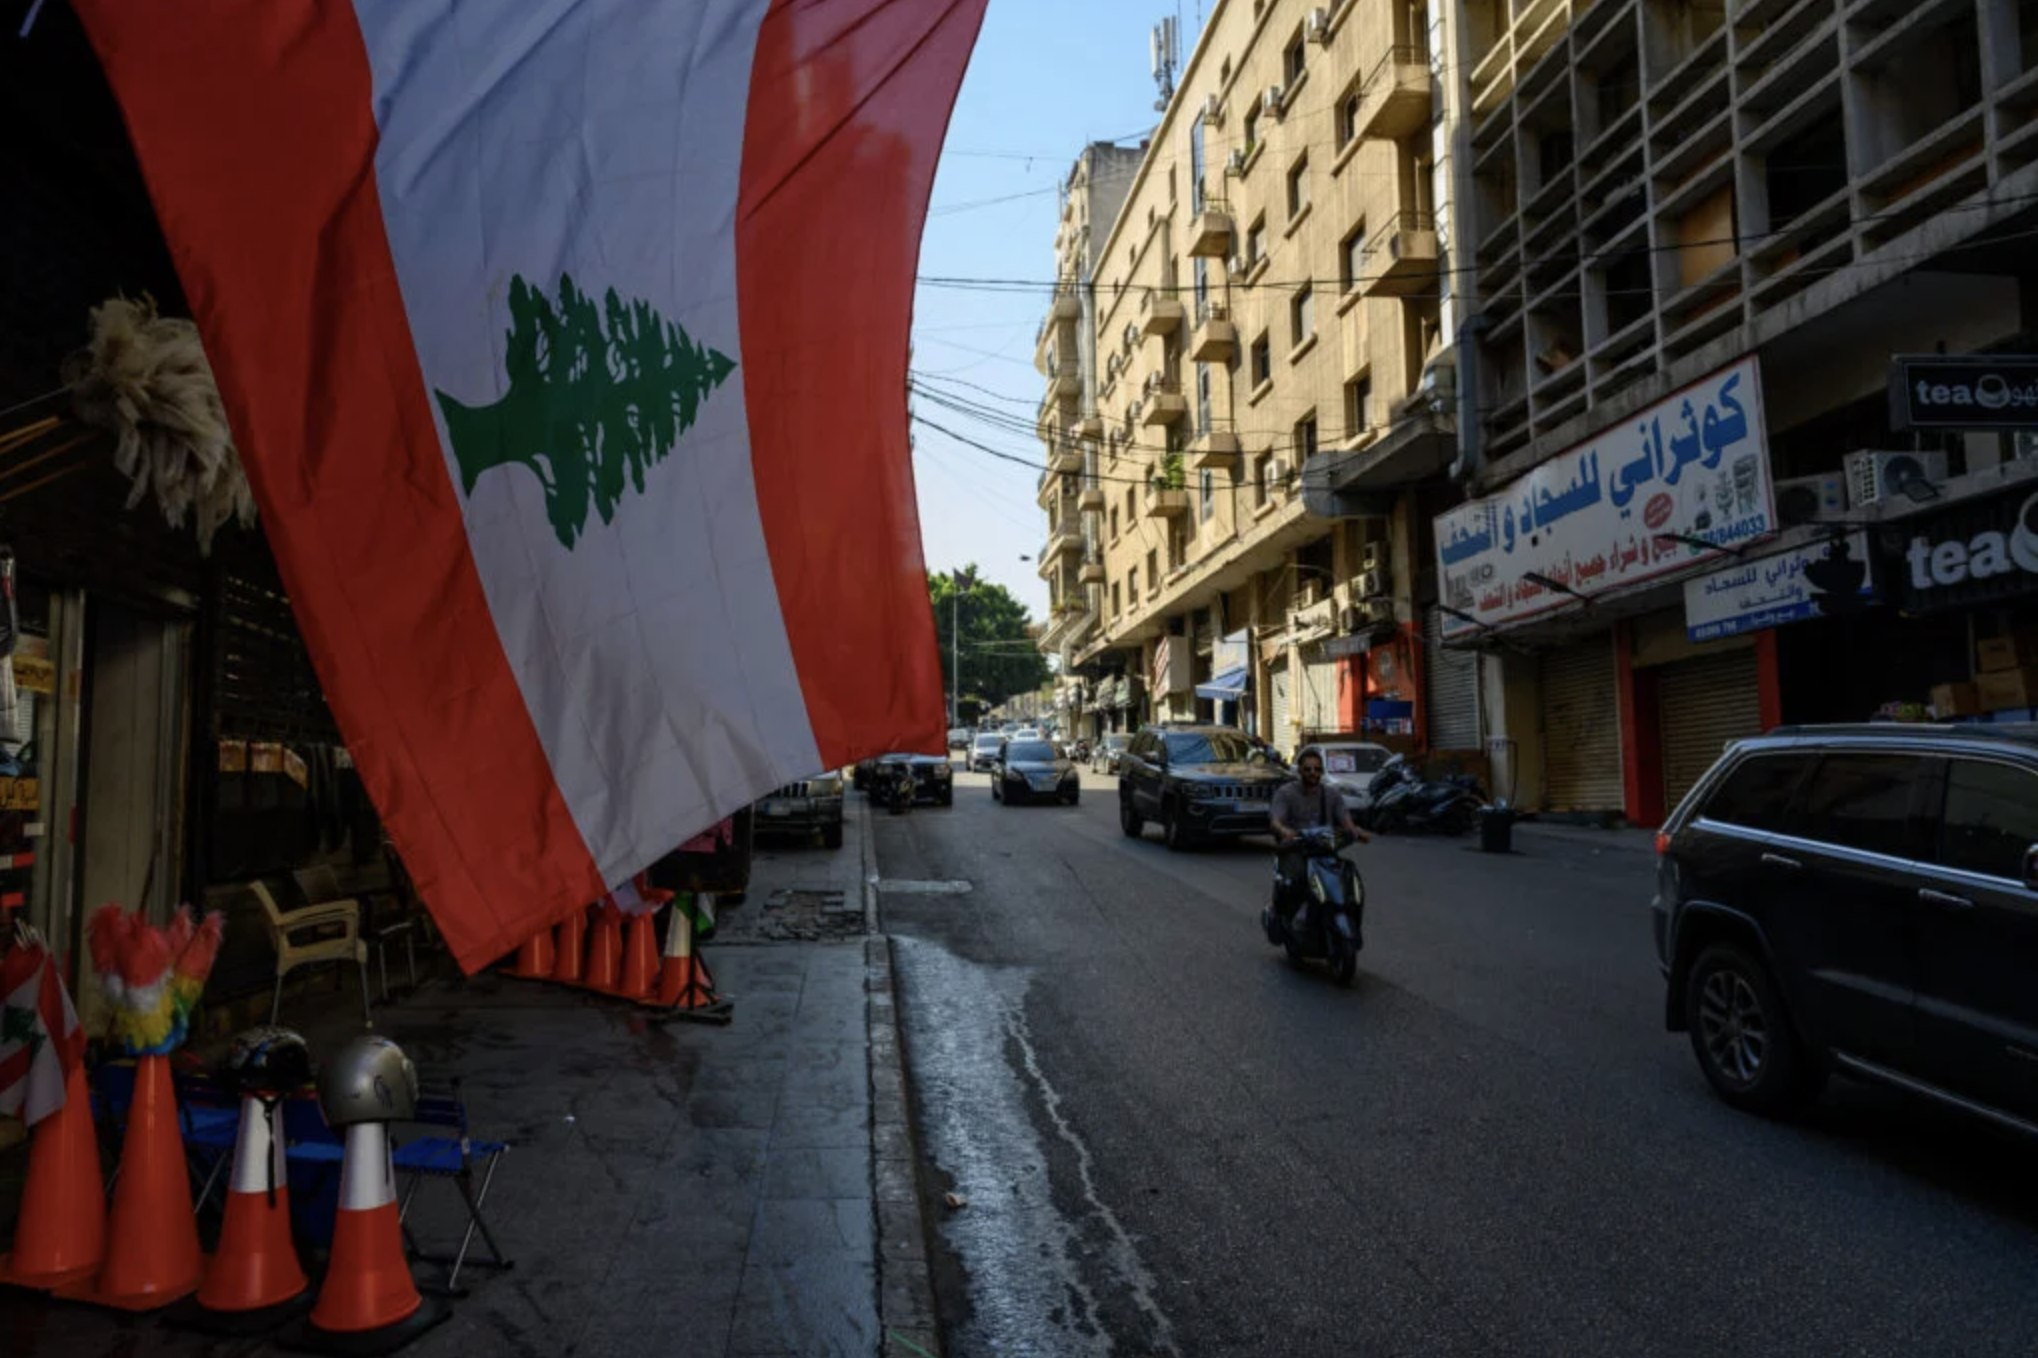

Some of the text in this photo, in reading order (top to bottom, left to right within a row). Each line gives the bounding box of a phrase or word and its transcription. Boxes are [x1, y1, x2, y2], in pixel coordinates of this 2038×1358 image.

[1915, 380, 1971, 405] tea
[1610, 372, 1748, 520] كوثراني
[1520, 451, 1601, 536] للسجاد
[1705, 566, 1757, 595] للسجاد
[1906, 529, 2011, 591] tea
